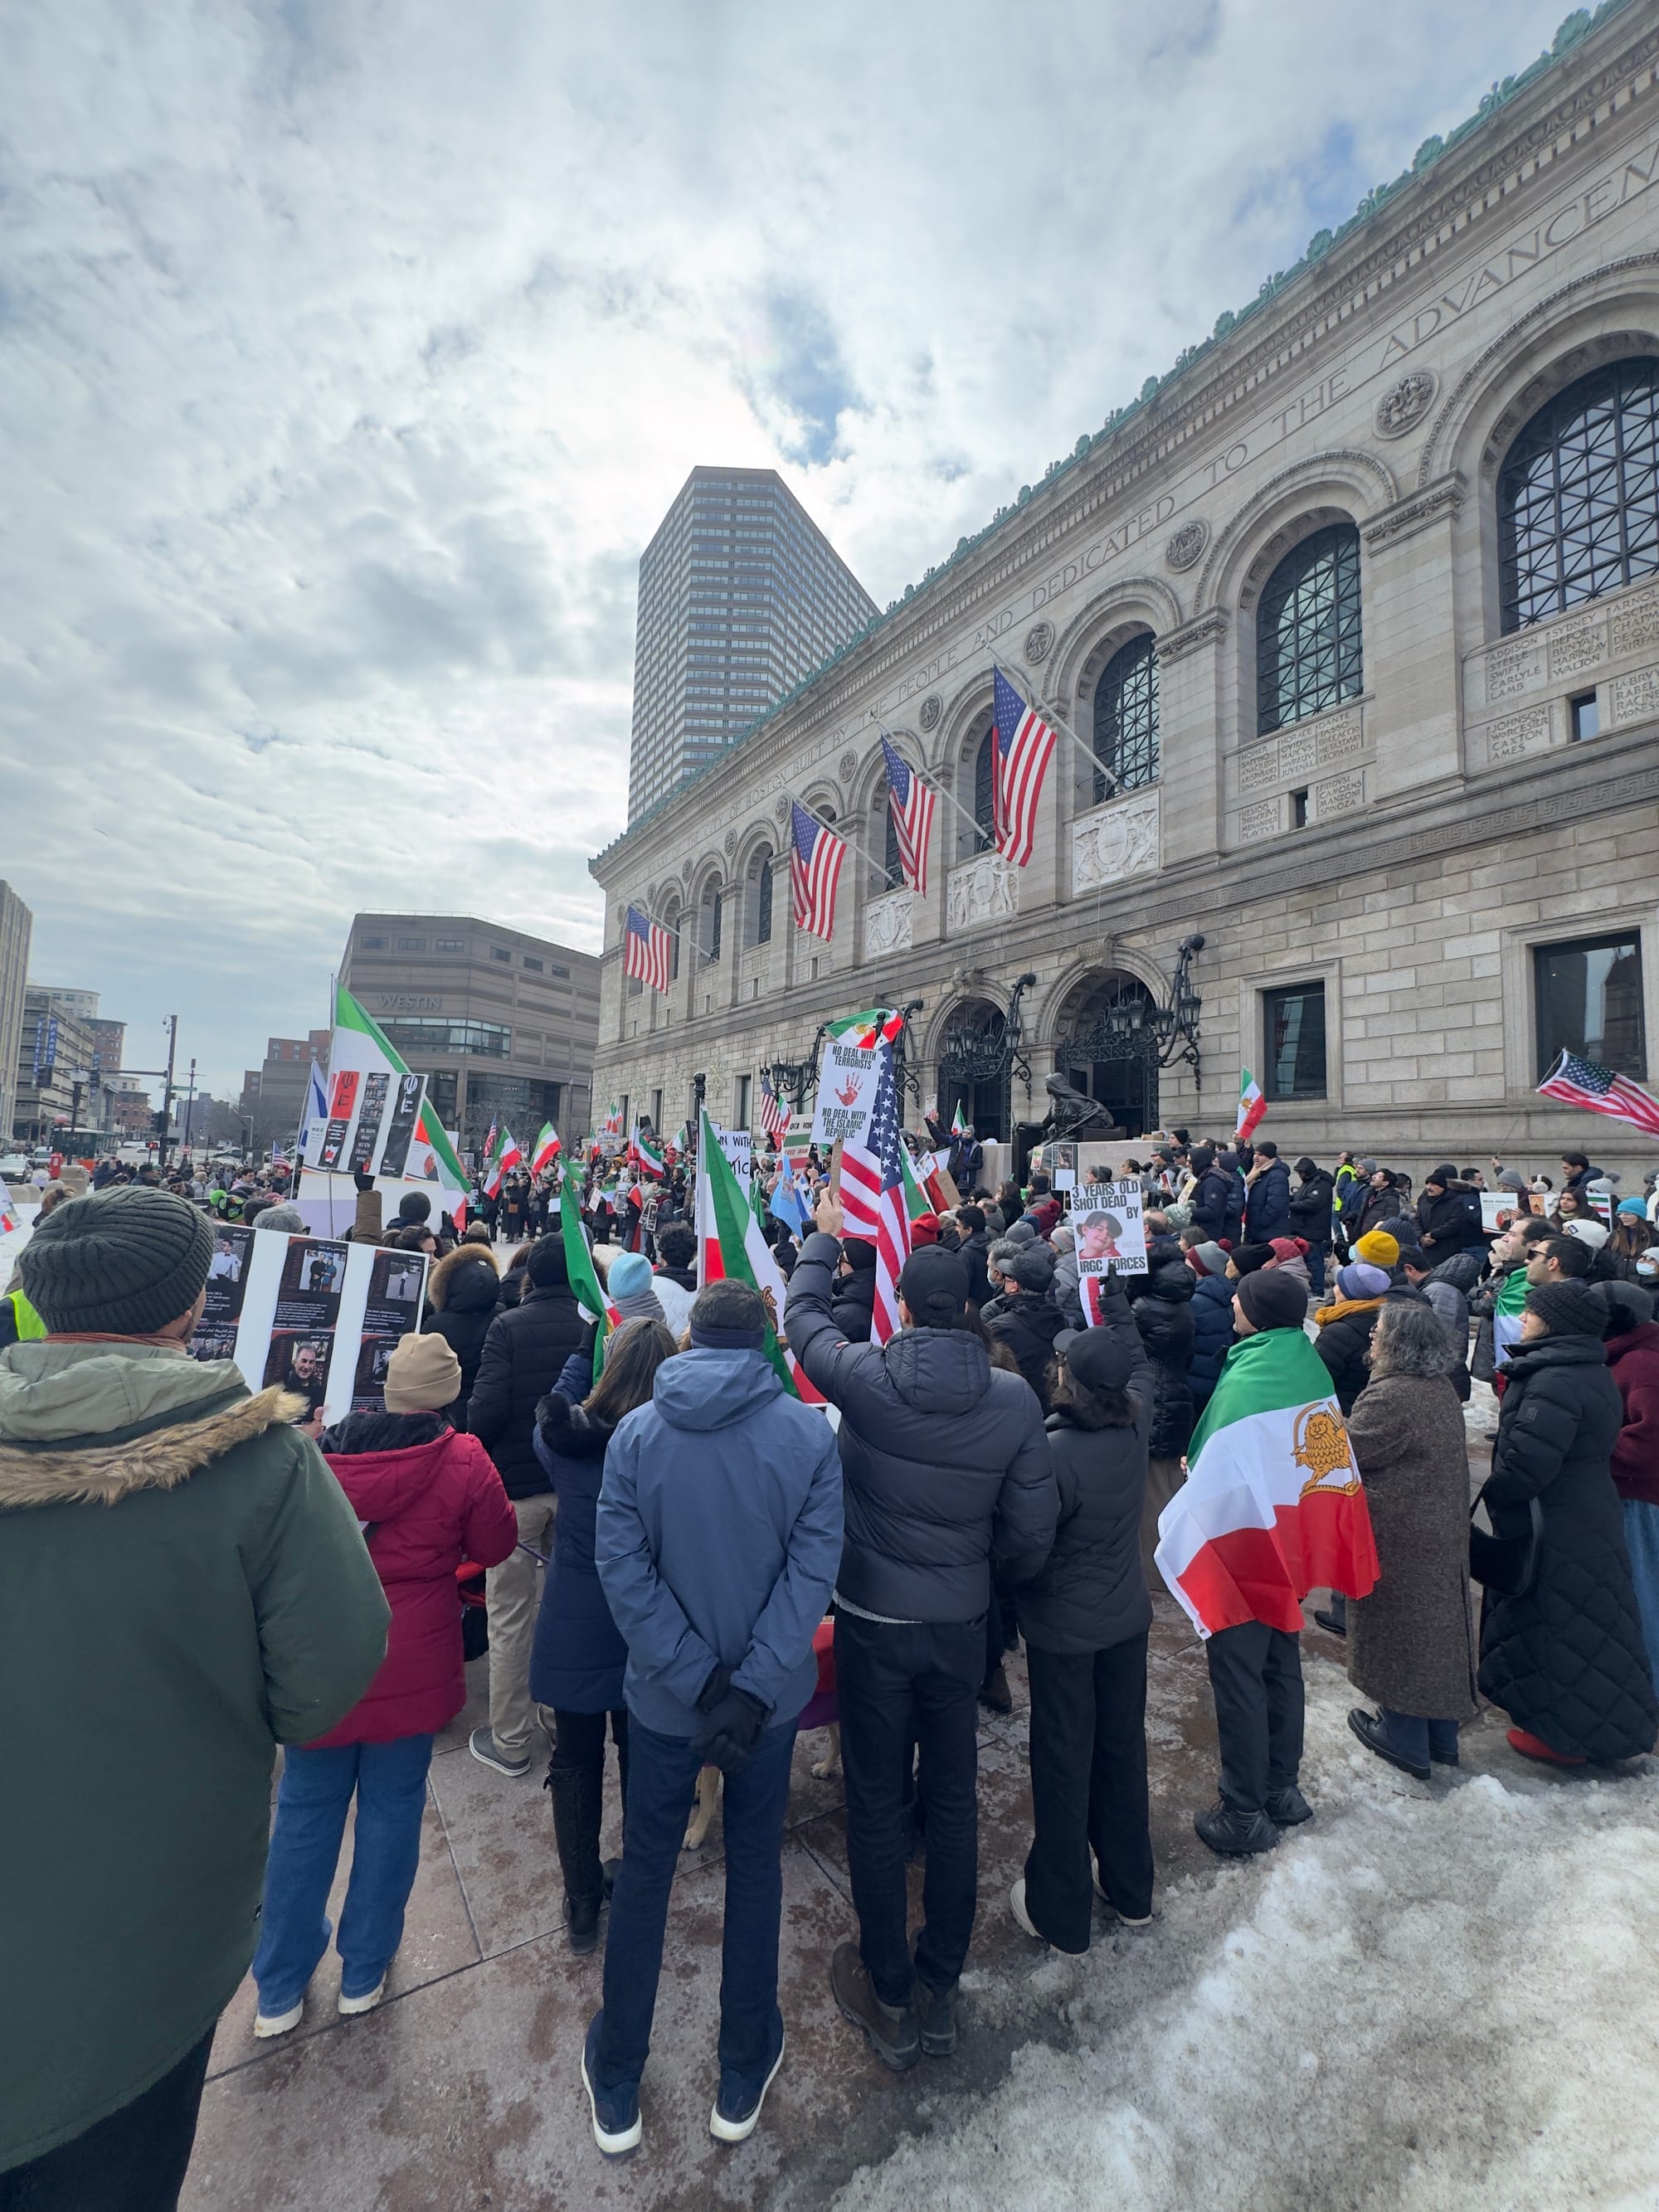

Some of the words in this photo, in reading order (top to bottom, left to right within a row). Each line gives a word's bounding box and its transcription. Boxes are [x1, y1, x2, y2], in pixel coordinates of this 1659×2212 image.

[792, 742, 825, 775] BUILT
[832, 723, 849, 747] BY
[898, 648, 959, 701] PEOPLE
[971, 610, 1014, 652] AND
[1032, 496, 1175, 611] DEDICATED
[1204, 443, 1248, 484] TO
[1271, 368, 1352, 437] THE
[1551, 612, 1597, 637] SYDNEY
[1552, 626, 1589, 647] DEFOE
[1552, 633, 1599, 657] BUNYAN
[1490, 636, 1538, 661] ADDISON
[1490, 650, 1529, 672] STEELE
[1553, 653, 1600, 676] WALTON
[1490, 663, 1522, 682] SWIFT
[1490, 665, 1540, 690] CARLYLE
[1490, 682, 1524, 700] LAMB
[1318, 712, 1350, 729] DANTE
[1491, 707, 1545, 732] JOHNSON
[1491, 728, 1542, 750] CAXTON
[1492, 743, 1525, 760] AMES
[378, 993, 442, 1009] WESTIN
[832, 1045, 842, 1055] NO
[843, 1047, 859, 1057] DEAL
[860, 1049, 877, 1060] WITH
[834, 1055, 872, 1069] TERRORISTS
[822, 1107, 832, 1117] NO
[833, 1108, 849, 1119] DEAL
[851, 1110, 867, 1121] WITH
[823, 1117, 836, 1127] THE
[836, 1118, 863, 1130] ISLAMIC
[732, 1135, 752, 1147] WITH
[825, 1127, 855, 1138] REPUBLIC
[1072, 1187, 1078, 1198] 3
[1083, 1183, 1114, 1196] YEARS
[1120, 1181, 1138, 1194] OLD
[1073, 1197, 1098, 1210] SHOT
[1102, 1195, 1126, 1208] DEAD
[1126, 1207, 1138, 1219] BY
[1080, 1260, 1102, 1273] IRGC
